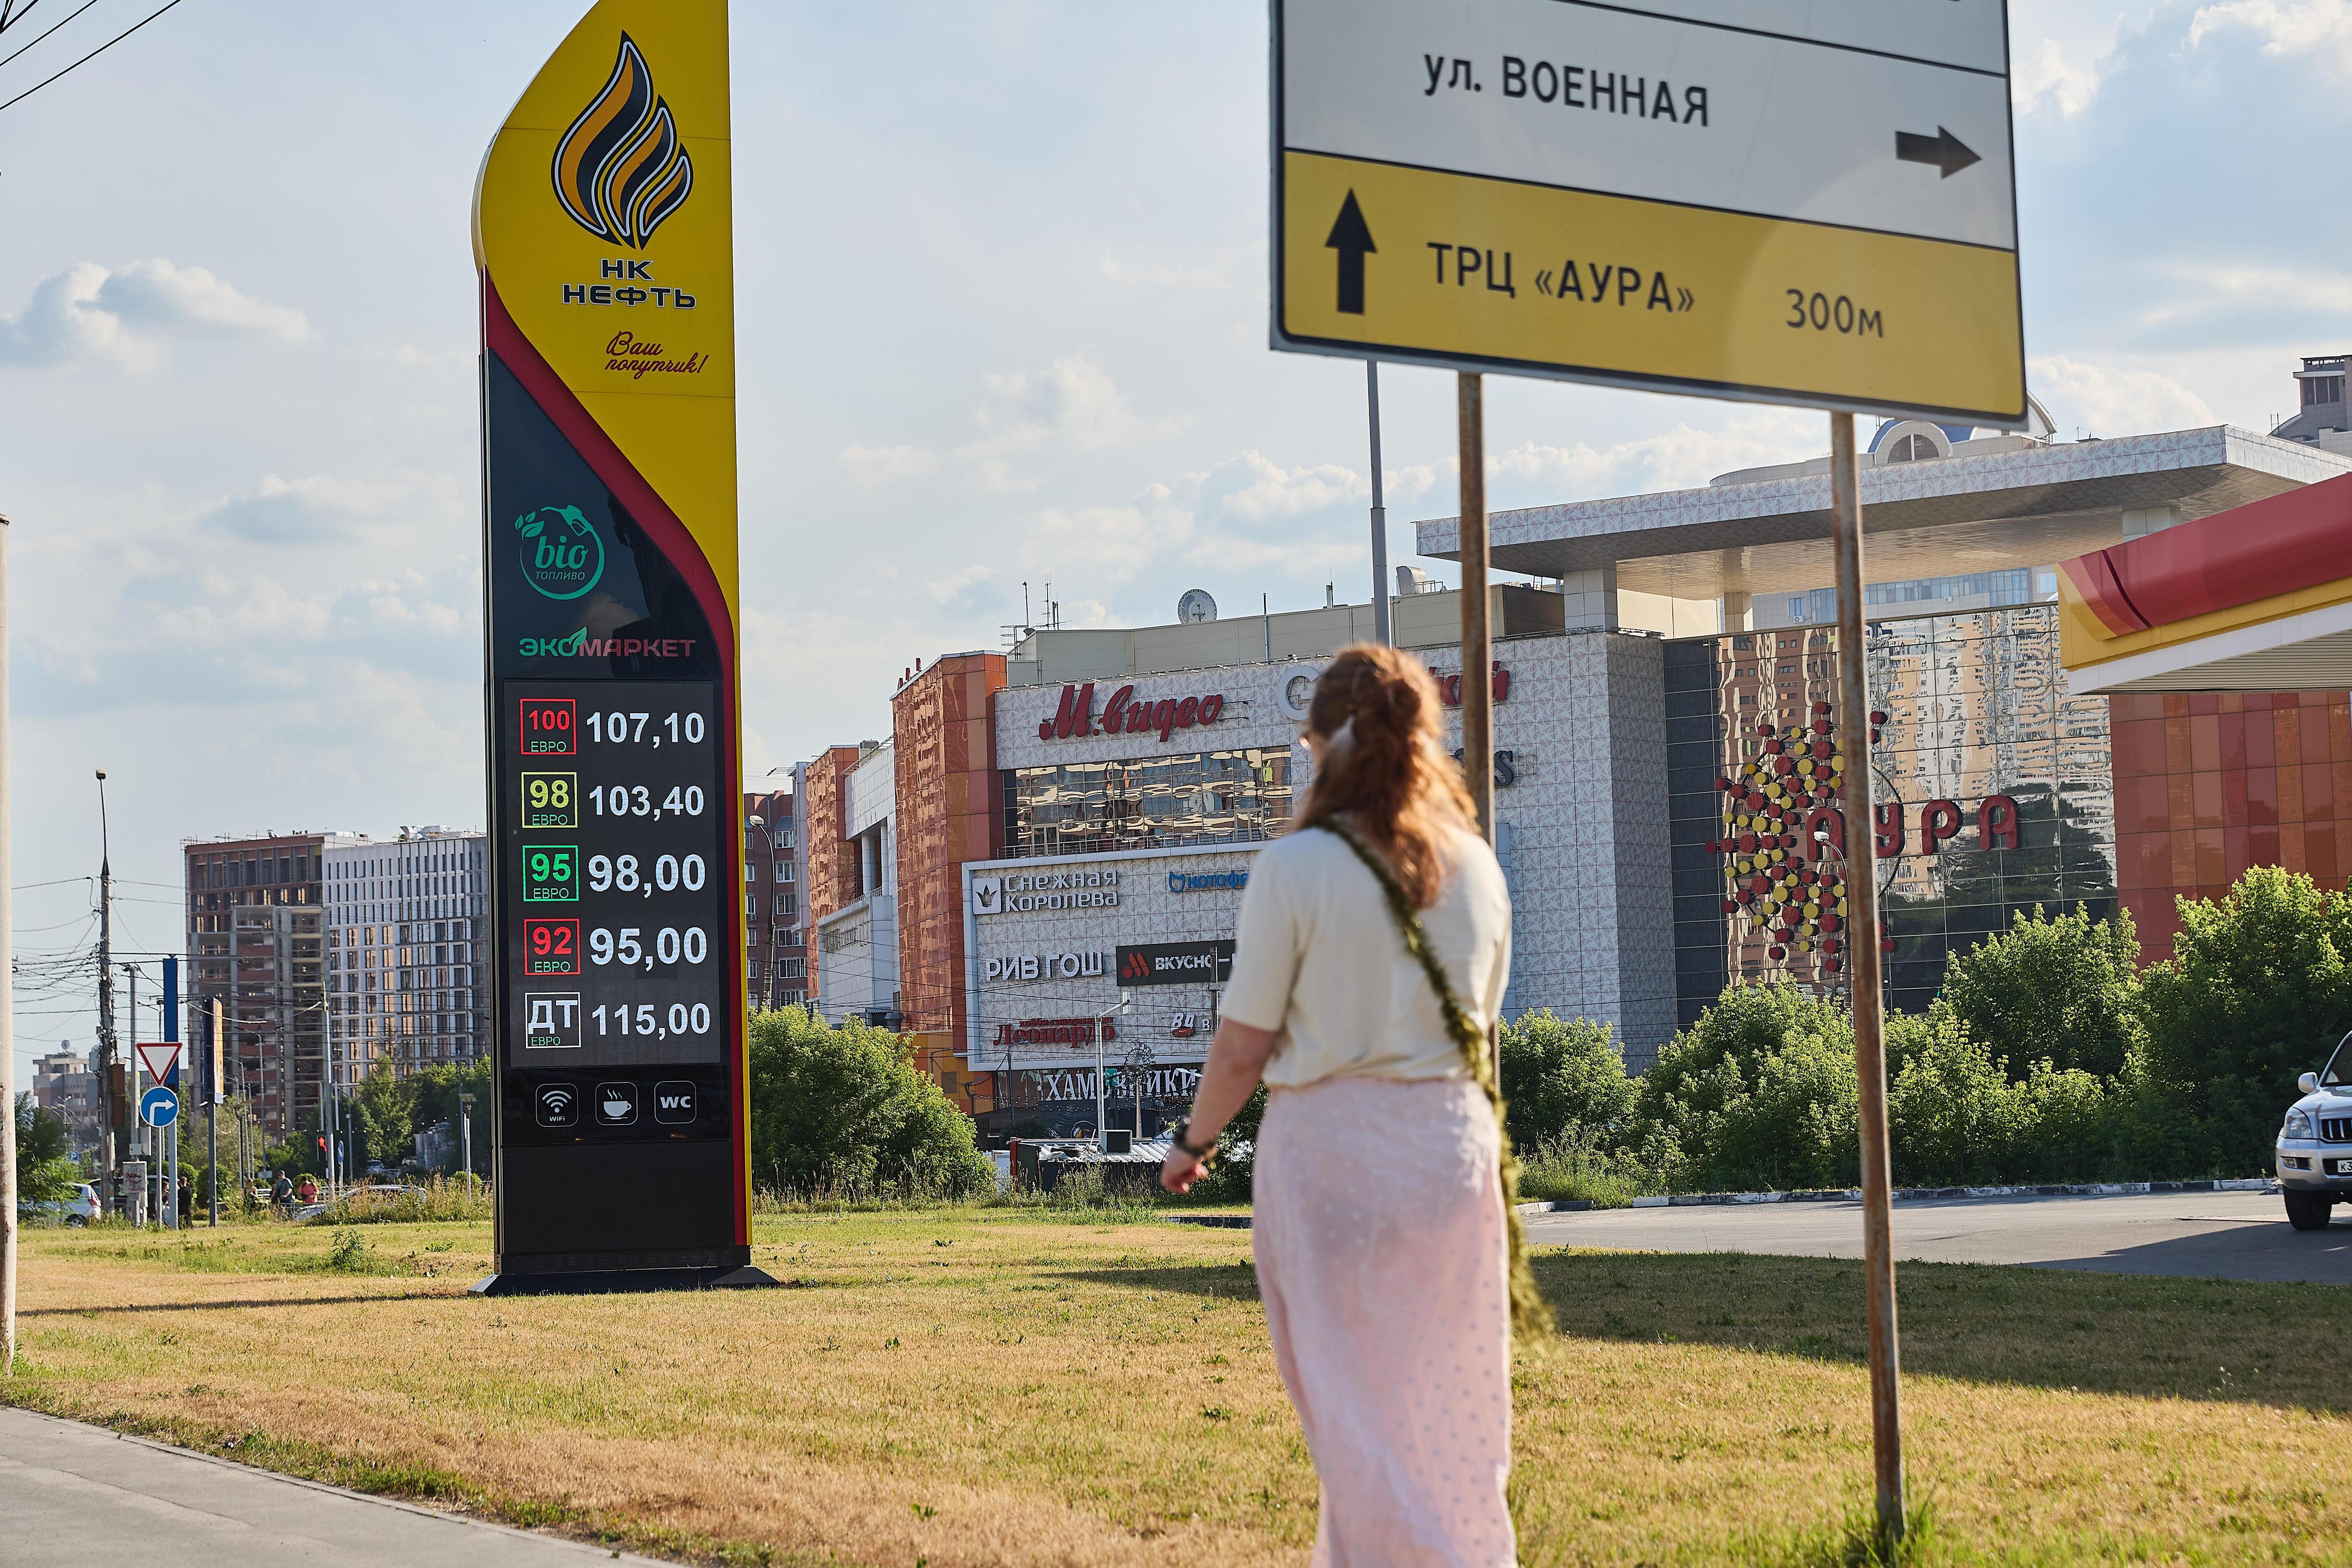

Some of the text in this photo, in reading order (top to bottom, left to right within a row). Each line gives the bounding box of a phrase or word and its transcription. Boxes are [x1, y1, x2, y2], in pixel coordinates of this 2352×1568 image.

[1423, 54, 1708, 128] ул. ВОЕННАЯ
[600, 258, 655, 281] НК
[562, 283, 697, 310] НЕФТЬ
[1426, 241, 1885, 339] ТРЦ «АУРА» 300м
[605, 330, 664, 356] Ваш
[604, 351, 709, 380] попутчик!
[535, 535, 589, 569] bio
[535, 571, 586, 581] ТОПЛИВО
[519, 637, 696, 658] ЭКОМАРКЕТ
[528, 709, 705, 749] 100 107,10
[531, 741, 567, 753] ЕВРО
[530, 779, 704, 822] 98 103,40
[532, 814, 568, 826] ЕВРО
[531, 852, 706, 899] 95 98,00
[1004, 870, 1118, 892] Снежная
[1187, 869, 1250, 889] котофе
[533, 887, 569, 899] ЕВРО
[1005, 891, 1118, 912] Королева
[532, 926, 707, 972] 92 95,00
[534, 961, 571, 973] ЕВРО
[528, 1000, 711, 1041] ДТ 115,00
[1019, 1016, 1114, 1027] хобби-гипермарет
[531, 1036, 561, 1047] ЕВРО
[1046, 1068, 1197, 1101] ХАМВИКИ
[660, 1095, 691, 1109] WC
